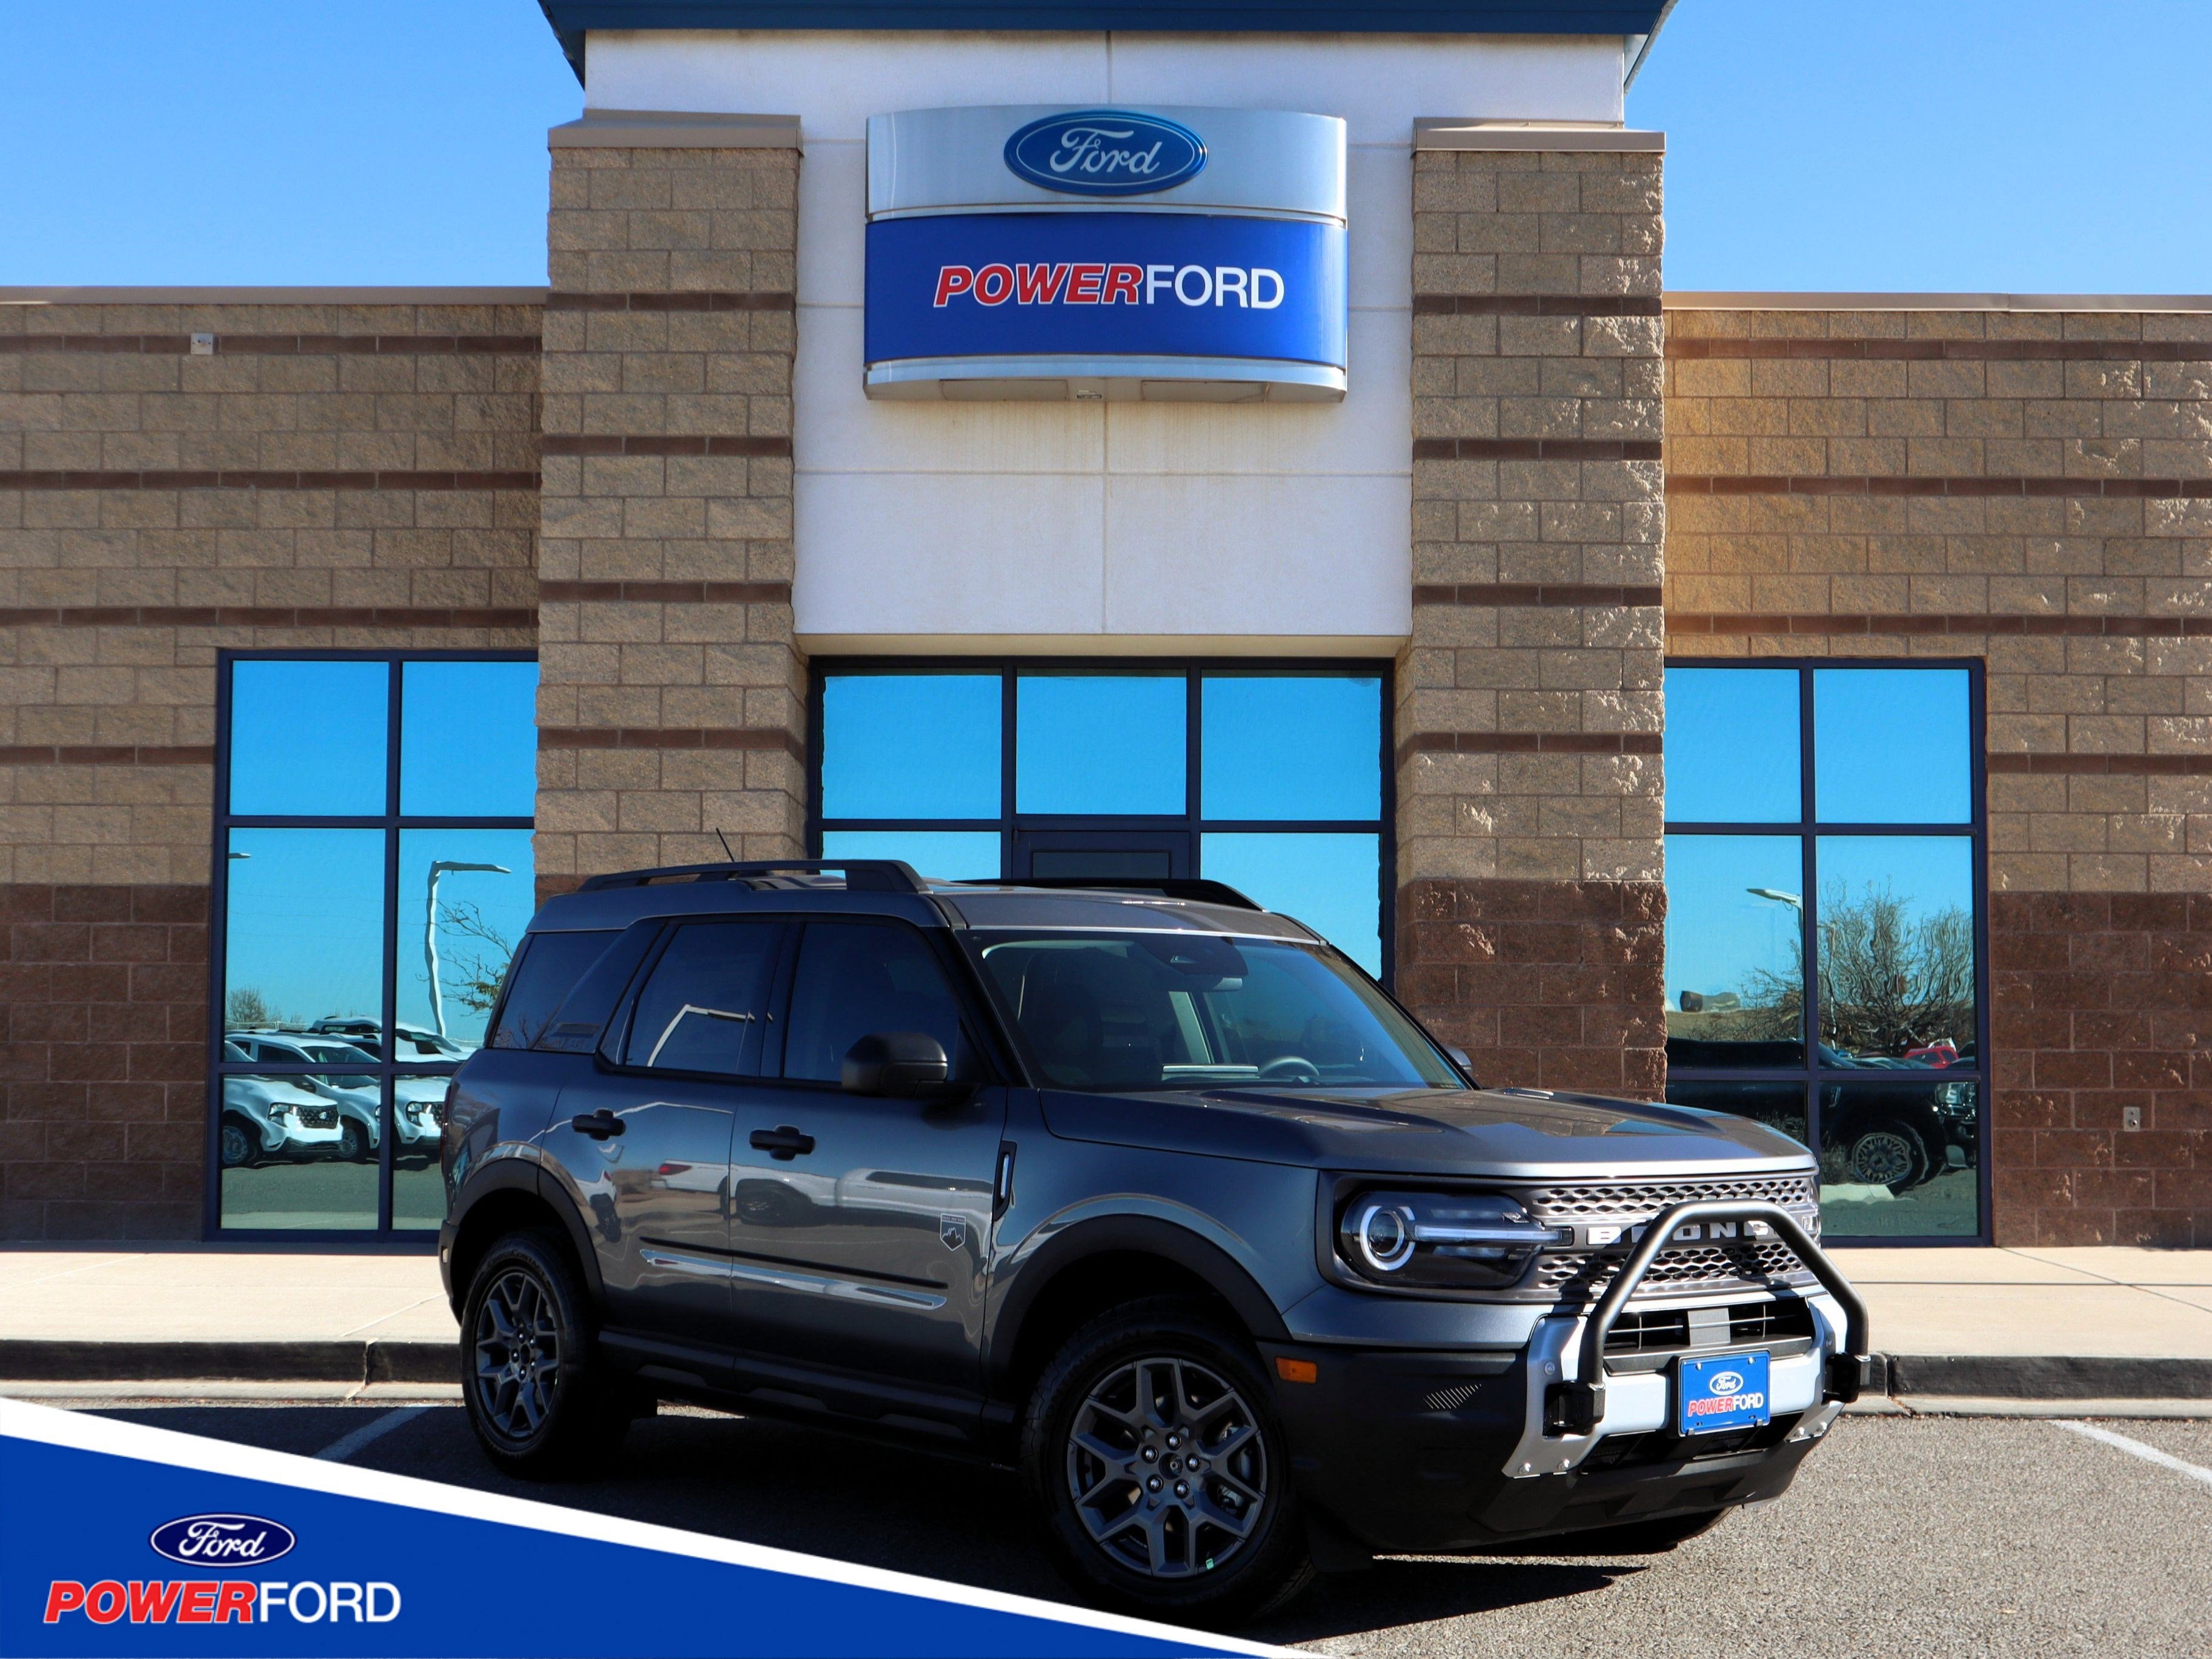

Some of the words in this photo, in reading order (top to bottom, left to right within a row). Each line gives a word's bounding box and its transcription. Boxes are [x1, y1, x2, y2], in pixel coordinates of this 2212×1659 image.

[1049, 127, 1163, 175] Ford
[934, 262, 1285, 310] POWERFORD
[1716, 1375, 1737, 1391] Ford
[1688, 1392, 1764, 1417] POWERFORD
